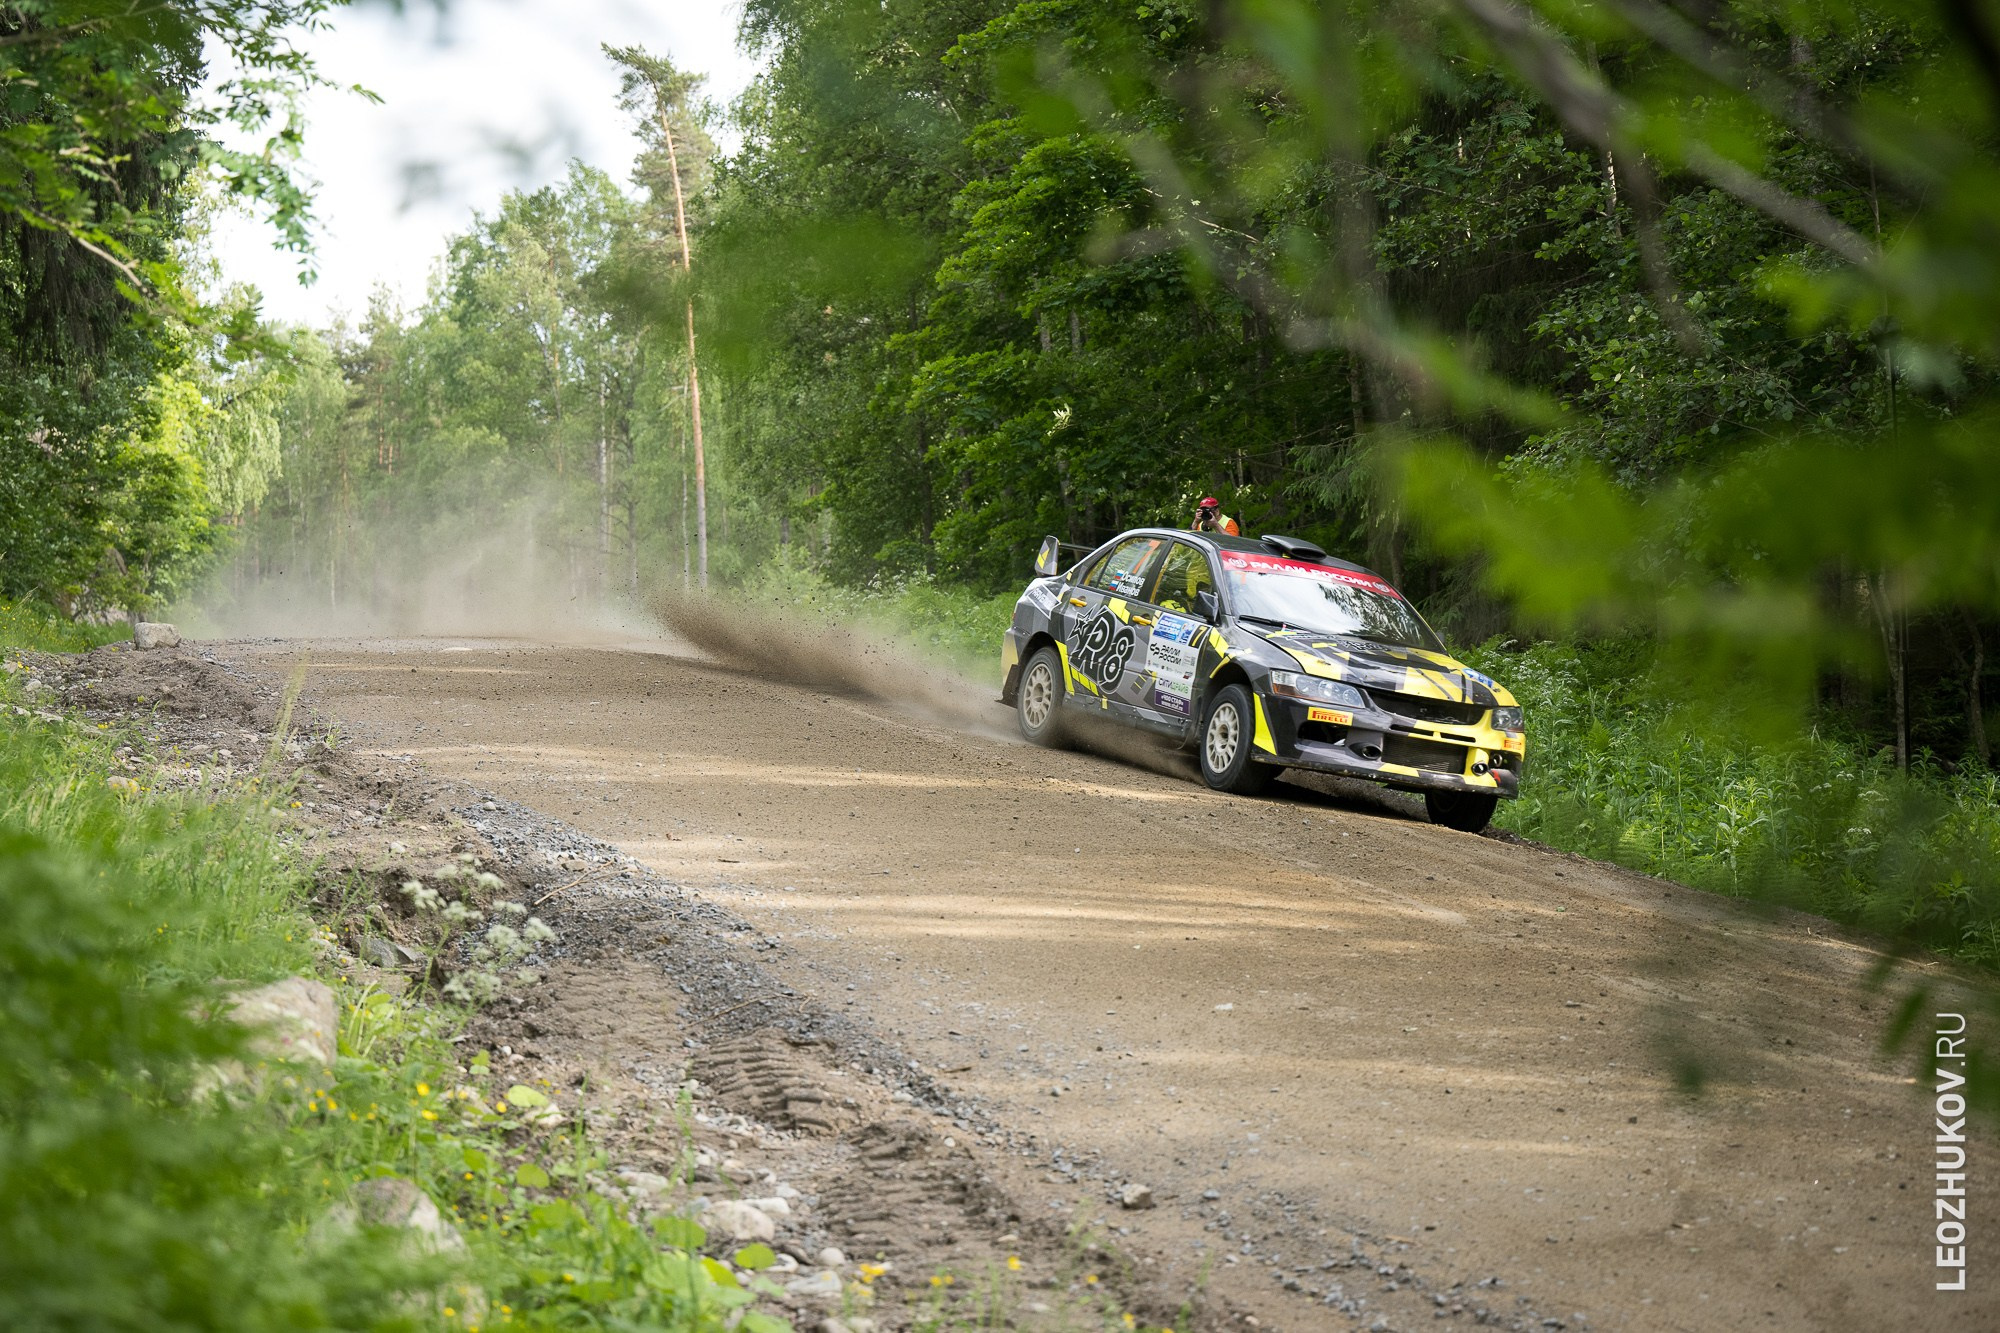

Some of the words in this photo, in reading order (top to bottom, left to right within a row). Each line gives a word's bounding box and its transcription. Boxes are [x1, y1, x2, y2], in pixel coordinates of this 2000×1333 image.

[1133, 540, 1160, 574] 7
[1250, 561, 1305, 577] РАЛЛИ
[1309, 568, 1372, 588] РОССИИ
[1116, 582, 1140, 597] Иванов
[1192, 625, 1208, 647] 7
[1160, 644, 1181, 656] РАЛЛИ
[1158, 652, 1182, 665] РОССИИ
[1312, 710, 1349, 723] PIRELLI
